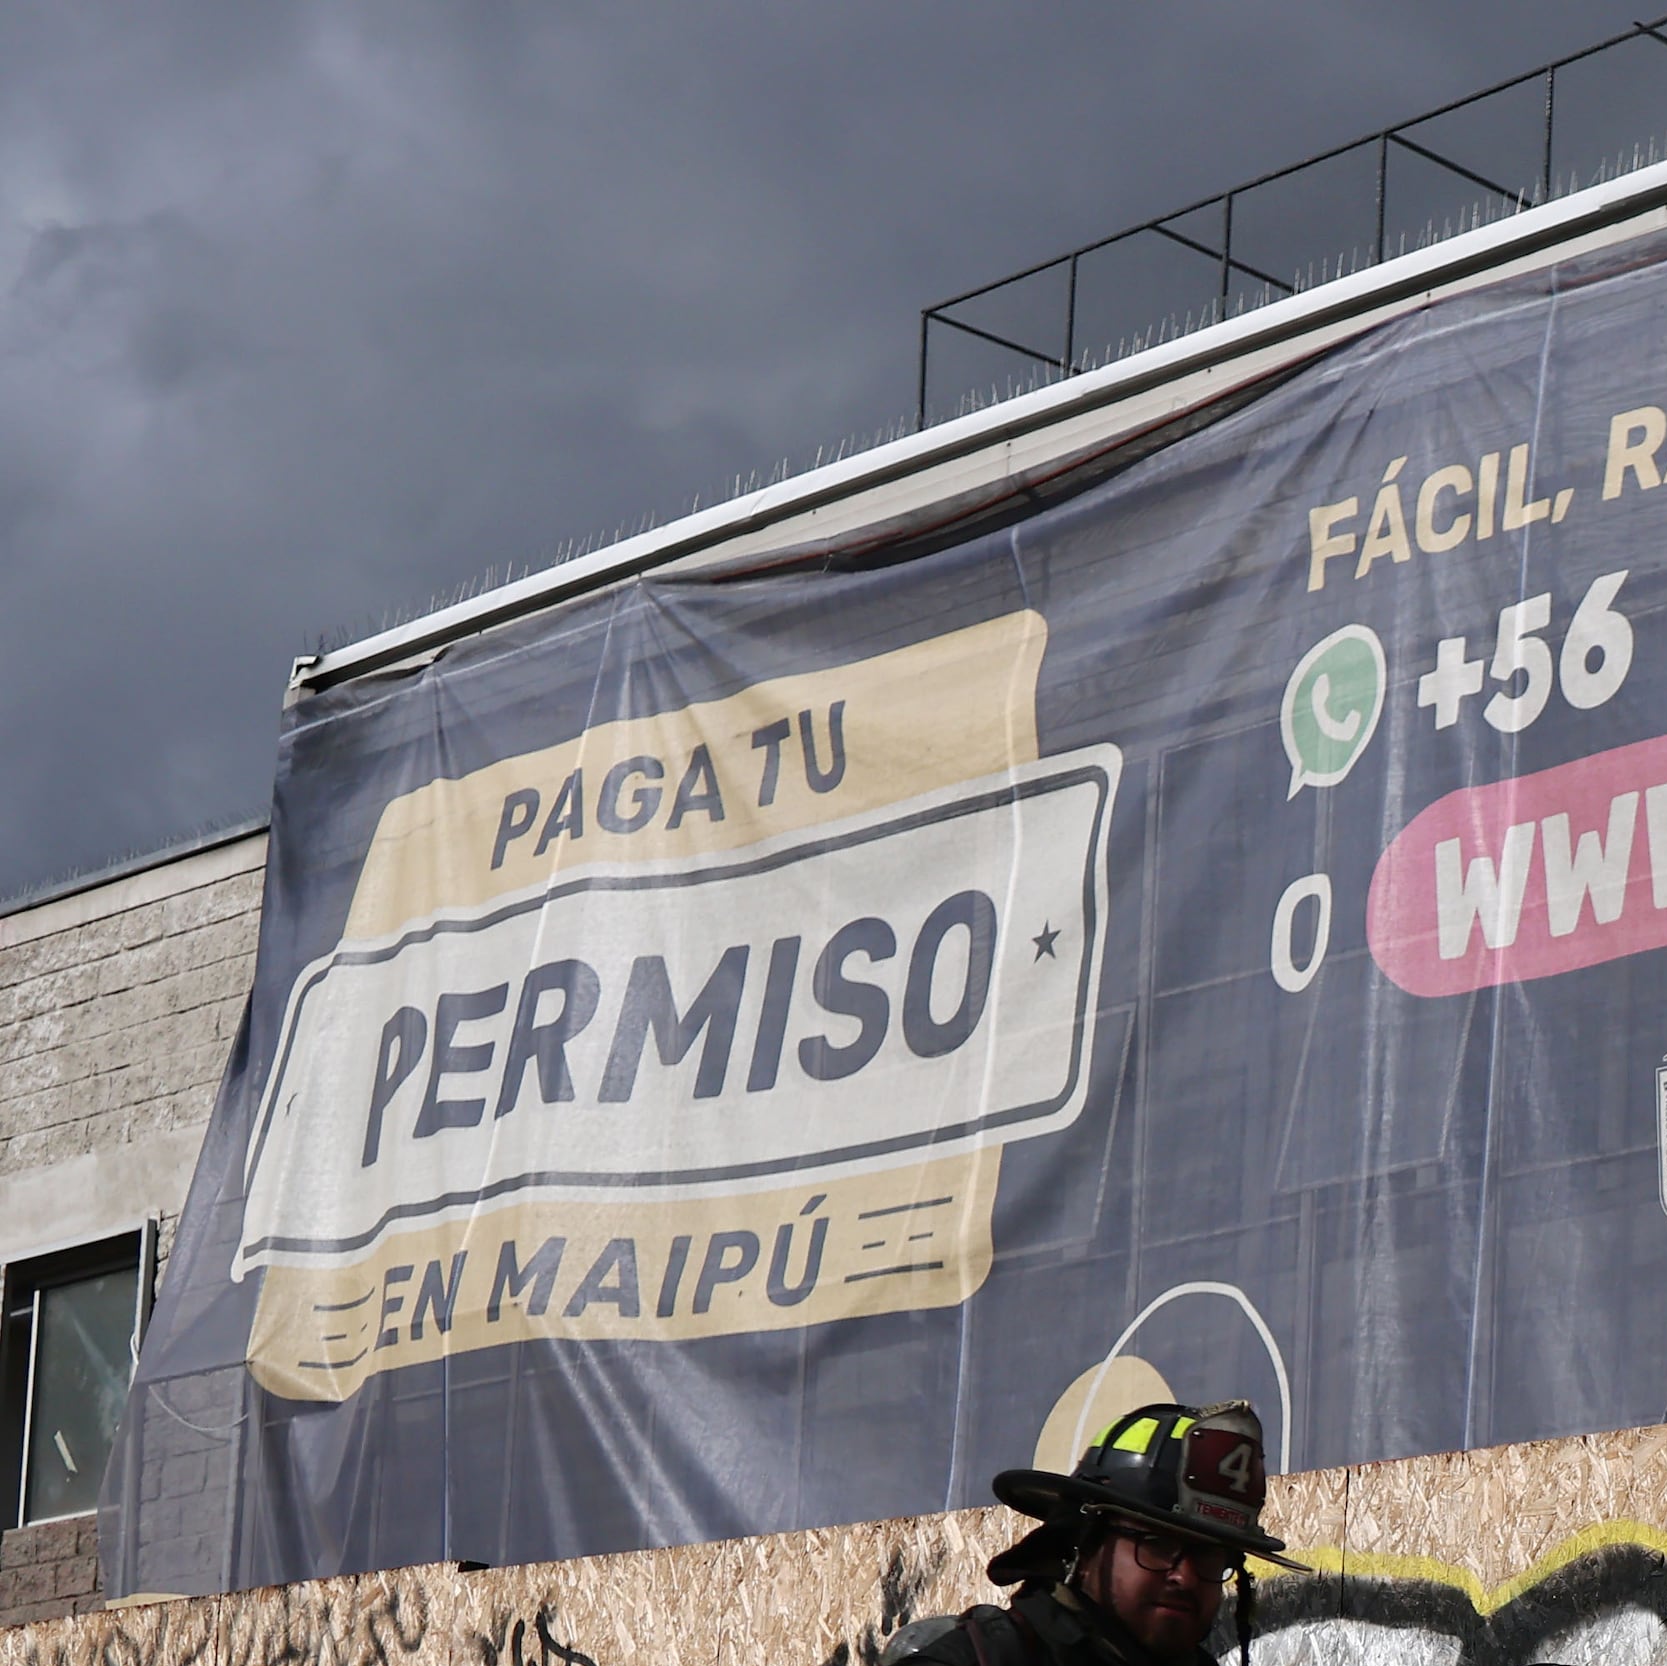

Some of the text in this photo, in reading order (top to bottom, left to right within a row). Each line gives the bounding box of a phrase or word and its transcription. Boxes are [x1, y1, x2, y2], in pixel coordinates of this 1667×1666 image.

[1307, 440, 1574, 591] FÁCIL,
[1416, 569, 1634, 733] +56
[489, 700, 848, 872] PAGA TU
[361, 889, 998, 1169] PERMISO
[372, 1193, 830, 1352] EN MAIPÚ
[1217, 1443, 1252, 1493] 4
